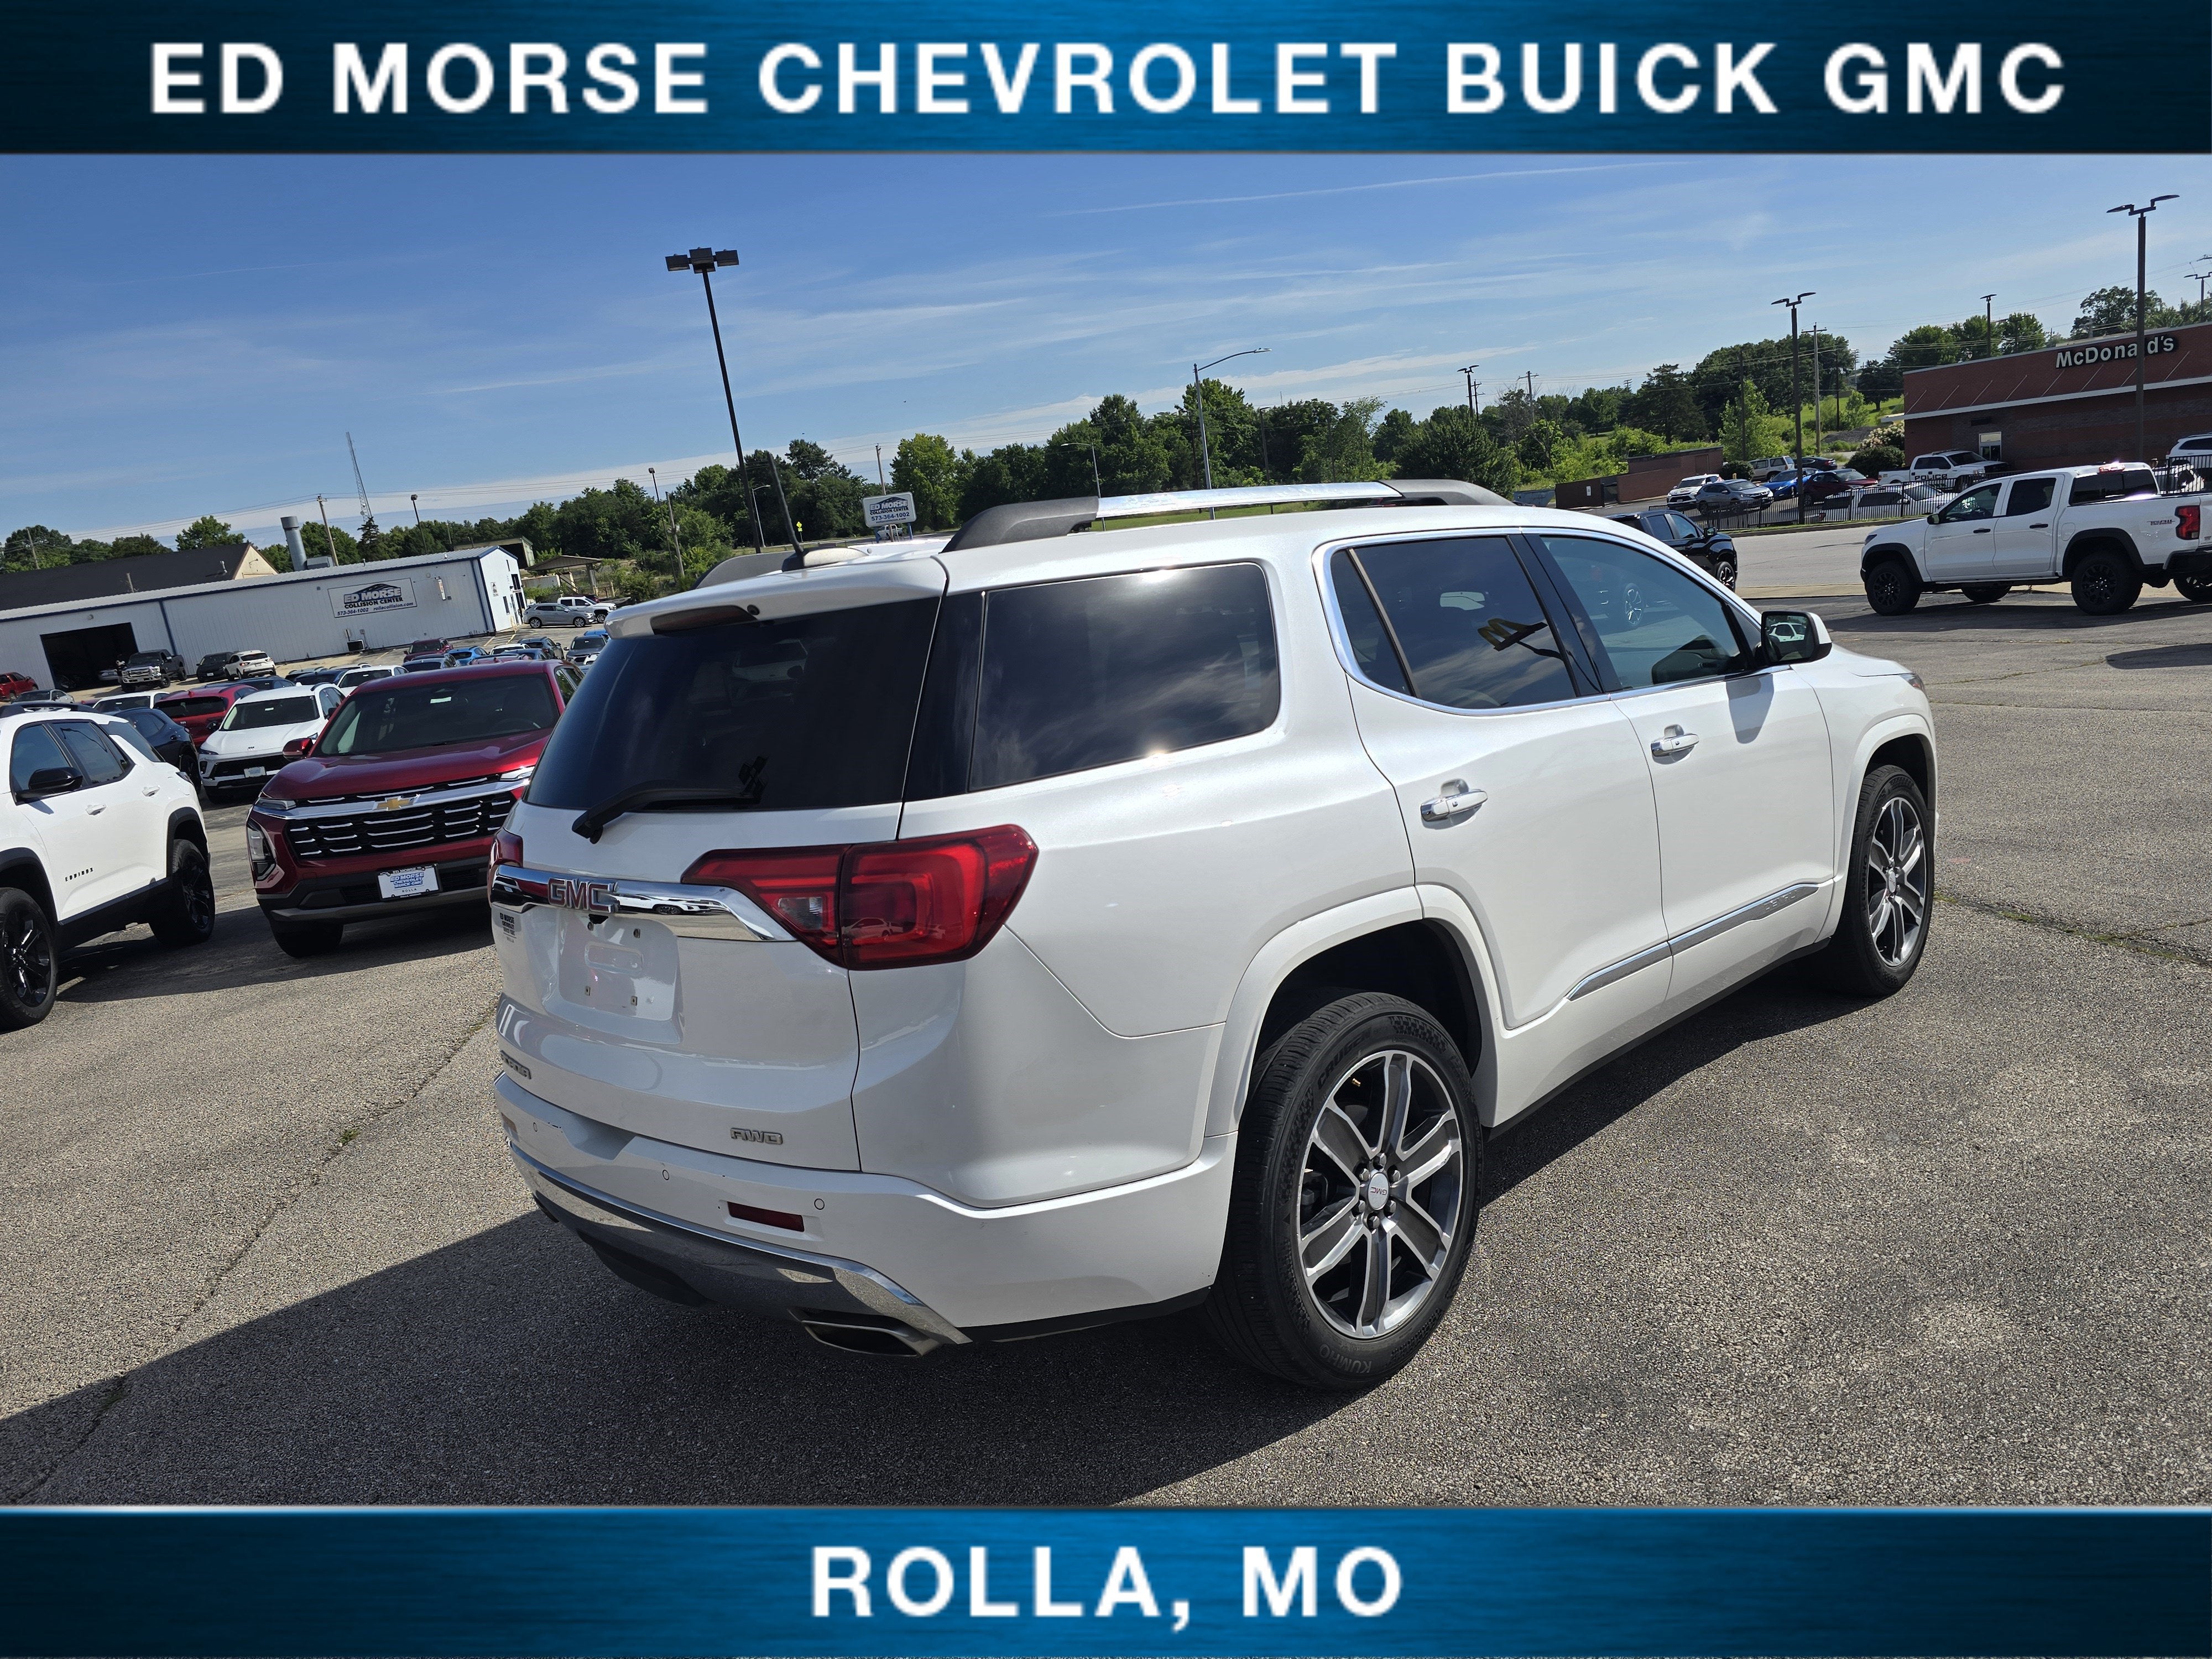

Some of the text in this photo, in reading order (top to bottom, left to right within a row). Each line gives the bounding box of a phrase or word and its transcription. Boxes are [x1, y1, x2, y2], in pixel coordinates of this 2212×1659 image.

[2056, 336, 2174, 368] McDonad's
[881, 500, 908, 509] MORSE
[872, 512, 910, 521] 573-364-1002
[344, 587, 401, 604] ED MORSE
[344, 600, 378, 609] COLLISION
[337, 608, 369, 616] 573-364-1002
[400, 872, 425, 880] MORSE
[548, 878, 612, 914] GMC
[731, 1128, 783, 1145] AWD
[1370, 1186, 1387, 1196] GMC
[1319, 1344, 1371, 1373] KUMHO
